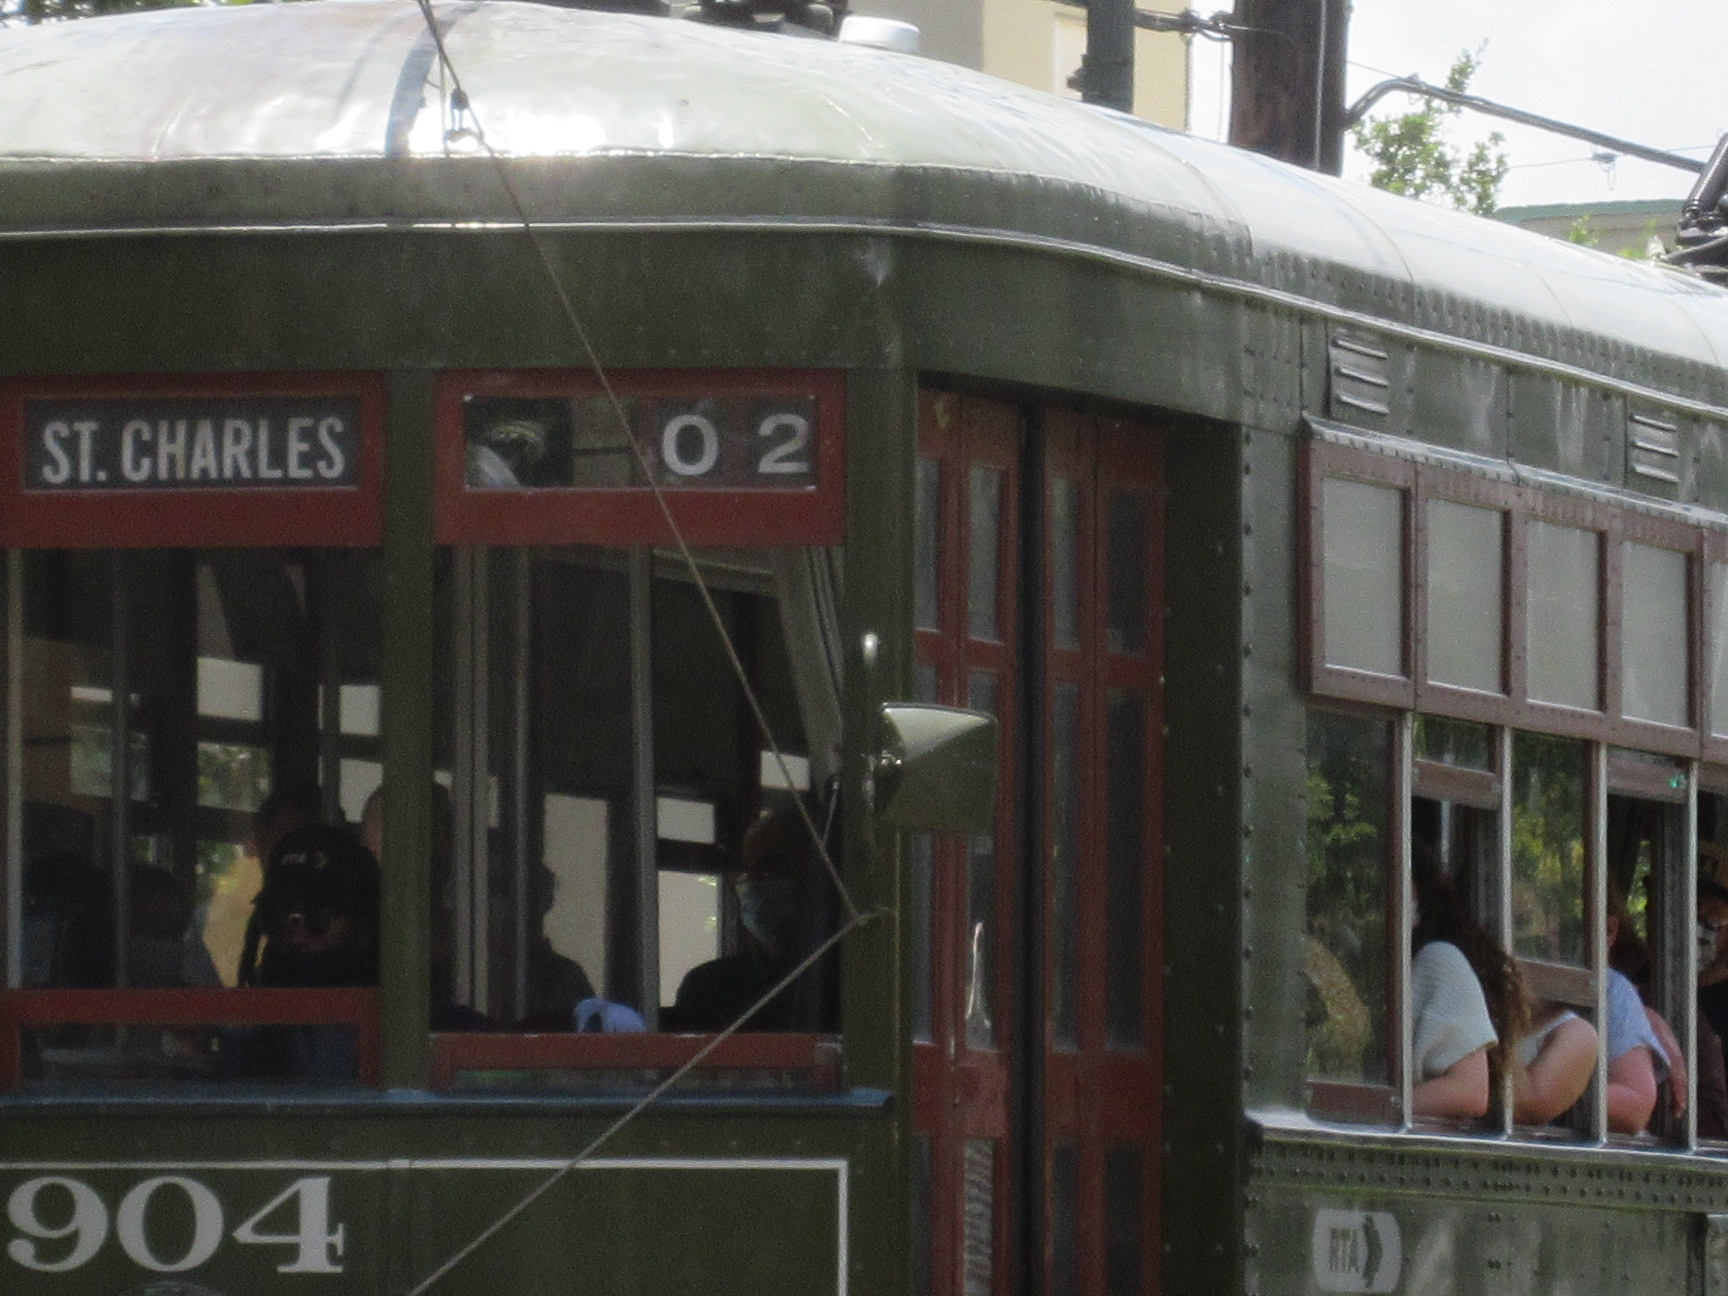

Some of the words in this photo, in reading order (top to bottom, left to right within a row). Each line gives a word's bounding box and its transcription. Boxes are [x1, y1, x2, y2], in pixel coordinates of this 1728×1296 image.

[41, 420, 107, 484] ST.
[122, 417, 345, 481] CHARLES
[7, 1176, 345, 1273] 904
